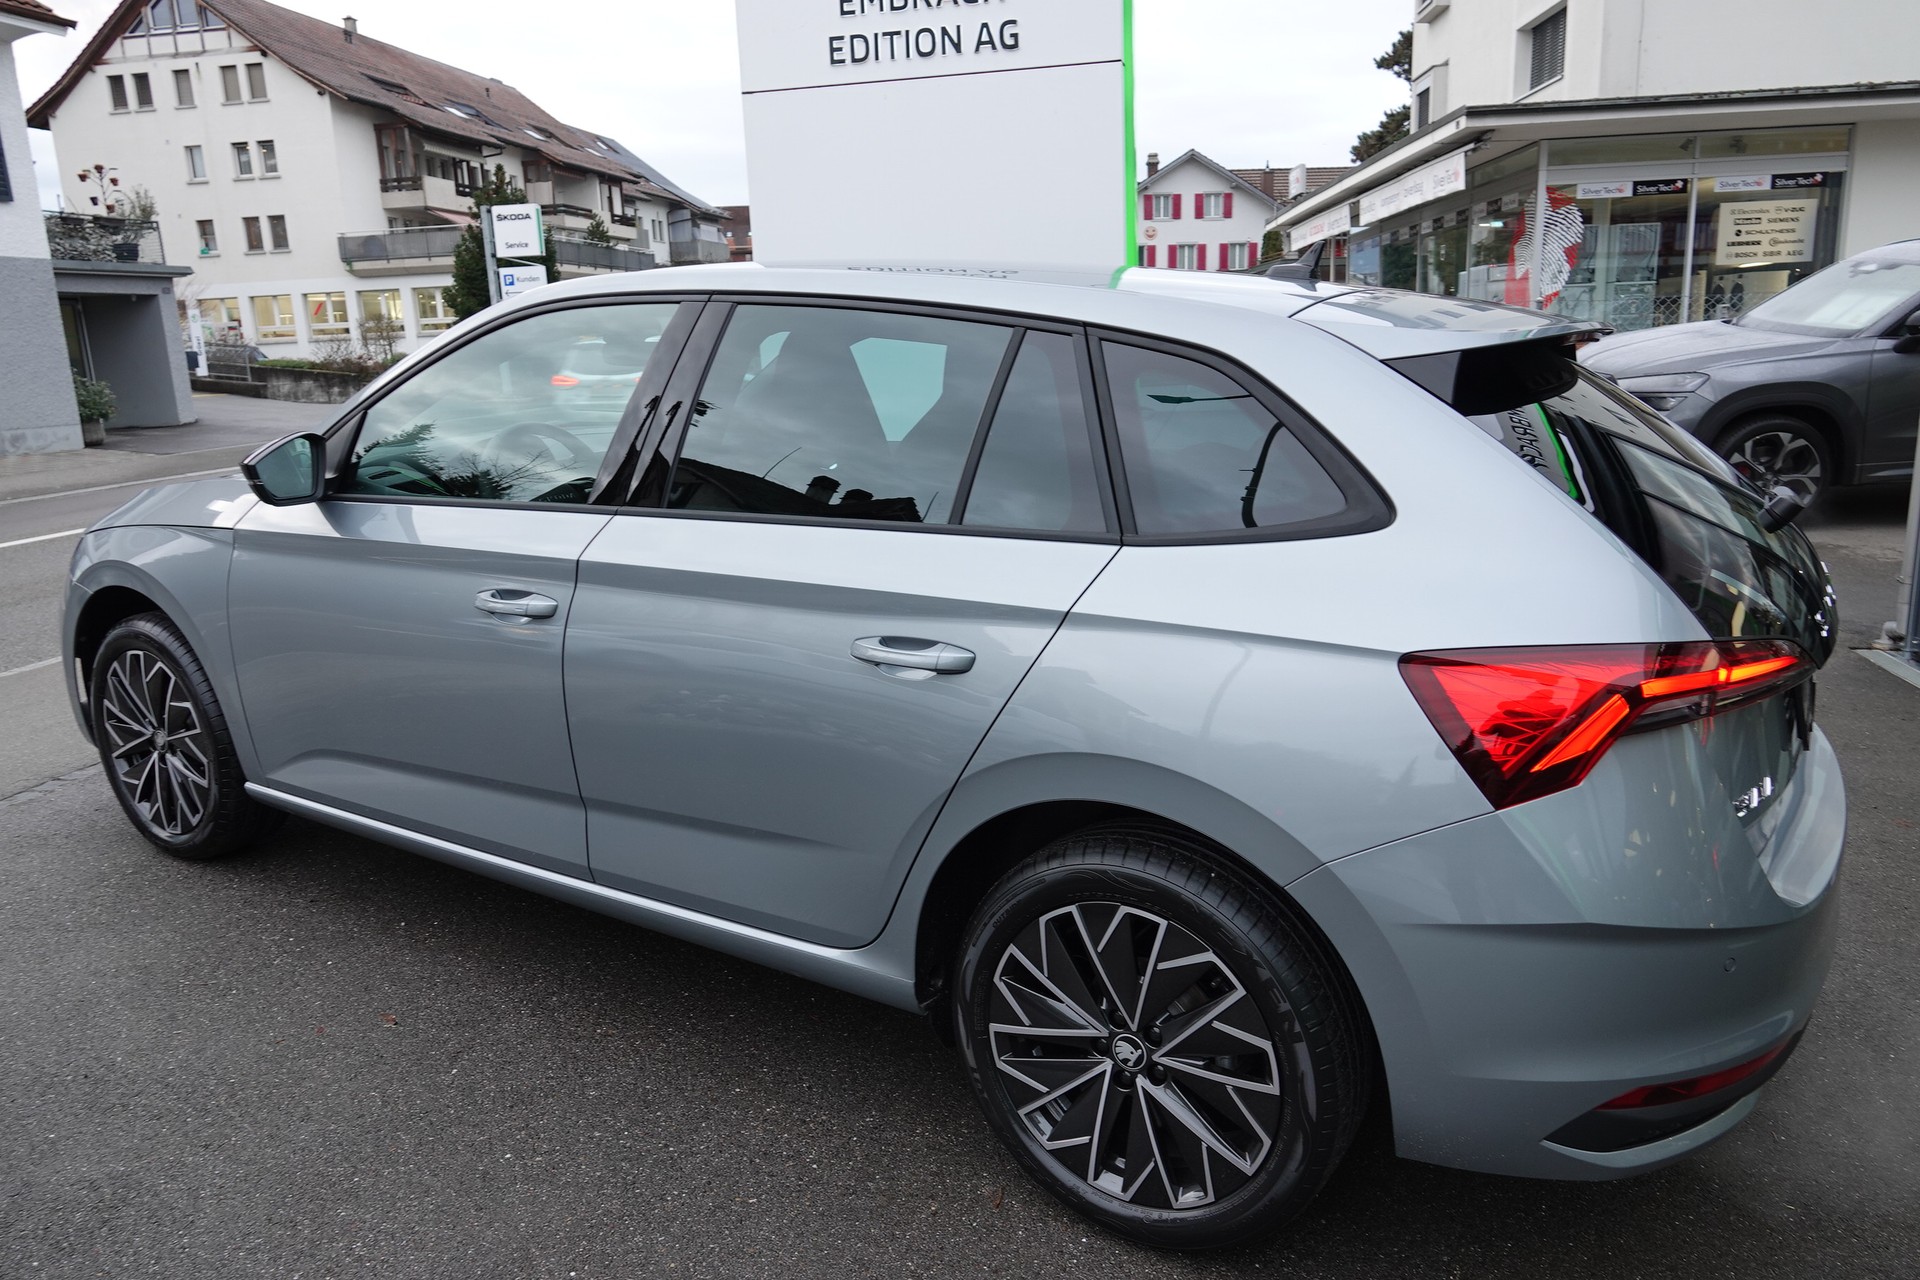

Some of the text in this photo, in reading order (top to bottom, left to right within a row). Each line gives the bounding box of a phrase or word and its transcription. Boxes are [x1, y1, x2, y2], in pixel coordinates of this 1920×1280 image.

[829, 19, 1020, 66] EDITION AG
[505, 241, 529, 249] Service
[516, 275, 540, 283] Kunden
